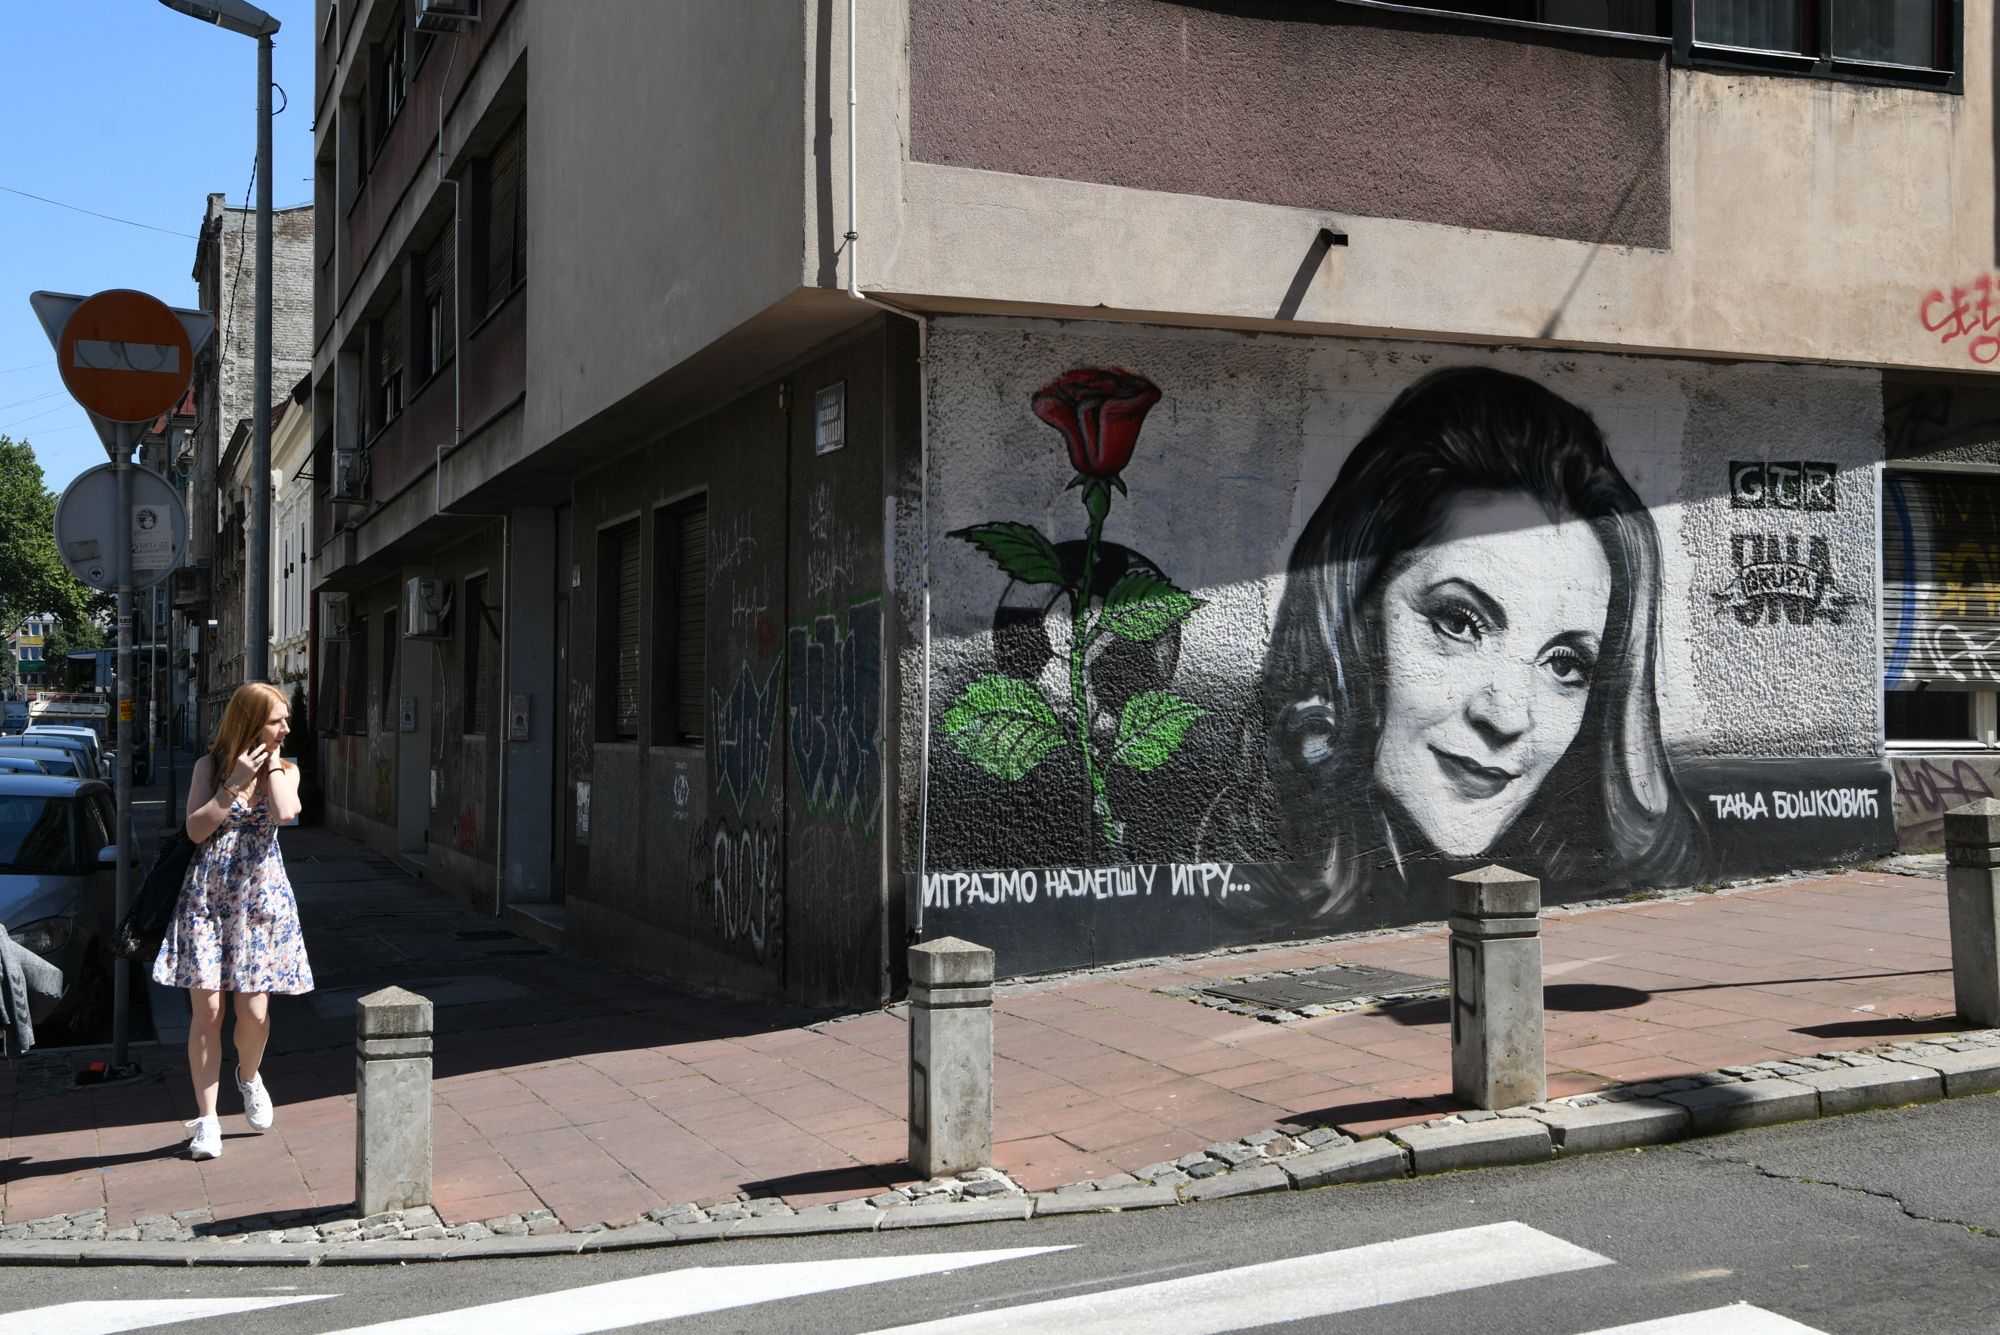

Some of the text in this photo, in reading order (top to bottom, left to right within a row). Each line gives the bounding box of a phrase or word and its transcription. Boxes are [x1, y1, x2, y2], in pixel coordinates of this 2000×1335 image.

[1708, 788, 1879, 820] ТАЊА БОШКОВИЋ
[922, 870, 1038, 909] ИГРАЈМО
